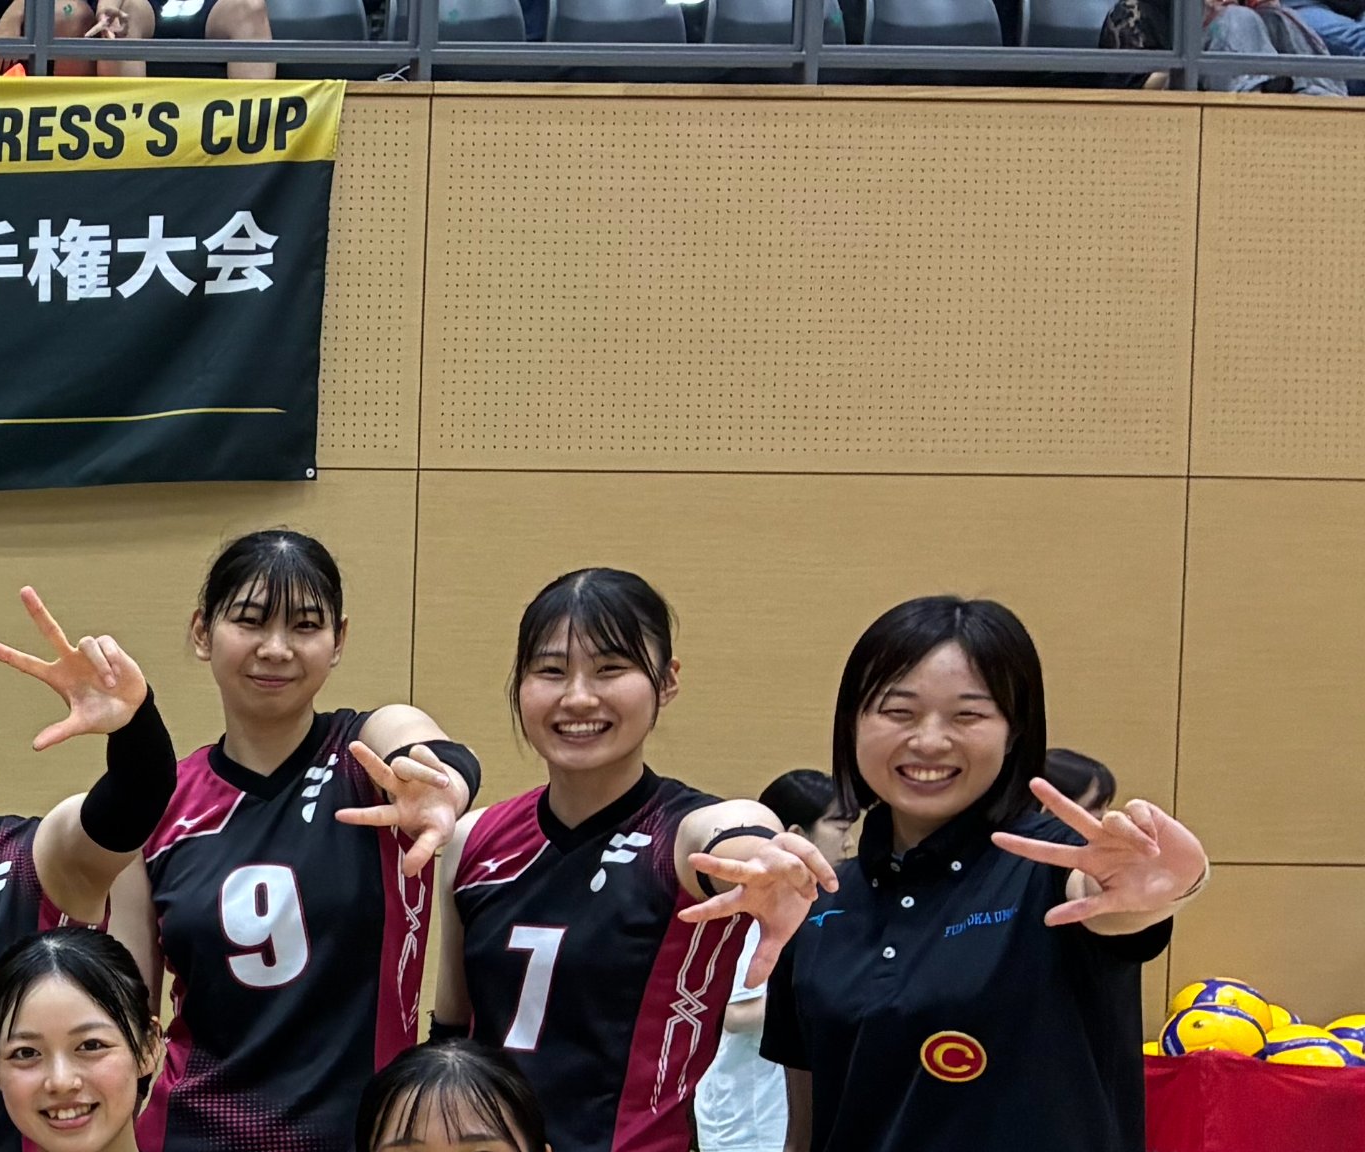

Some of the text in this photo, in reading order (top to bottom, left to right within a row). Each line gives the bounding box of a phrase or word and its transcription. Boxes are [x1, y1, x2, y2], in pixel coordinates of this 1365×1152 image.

[201, 95, 309, 154] CUP
[218, 863, 310, 988] 9
[505, 924, 567, 1052] 7
[933, 1042, 975, 1073] C
